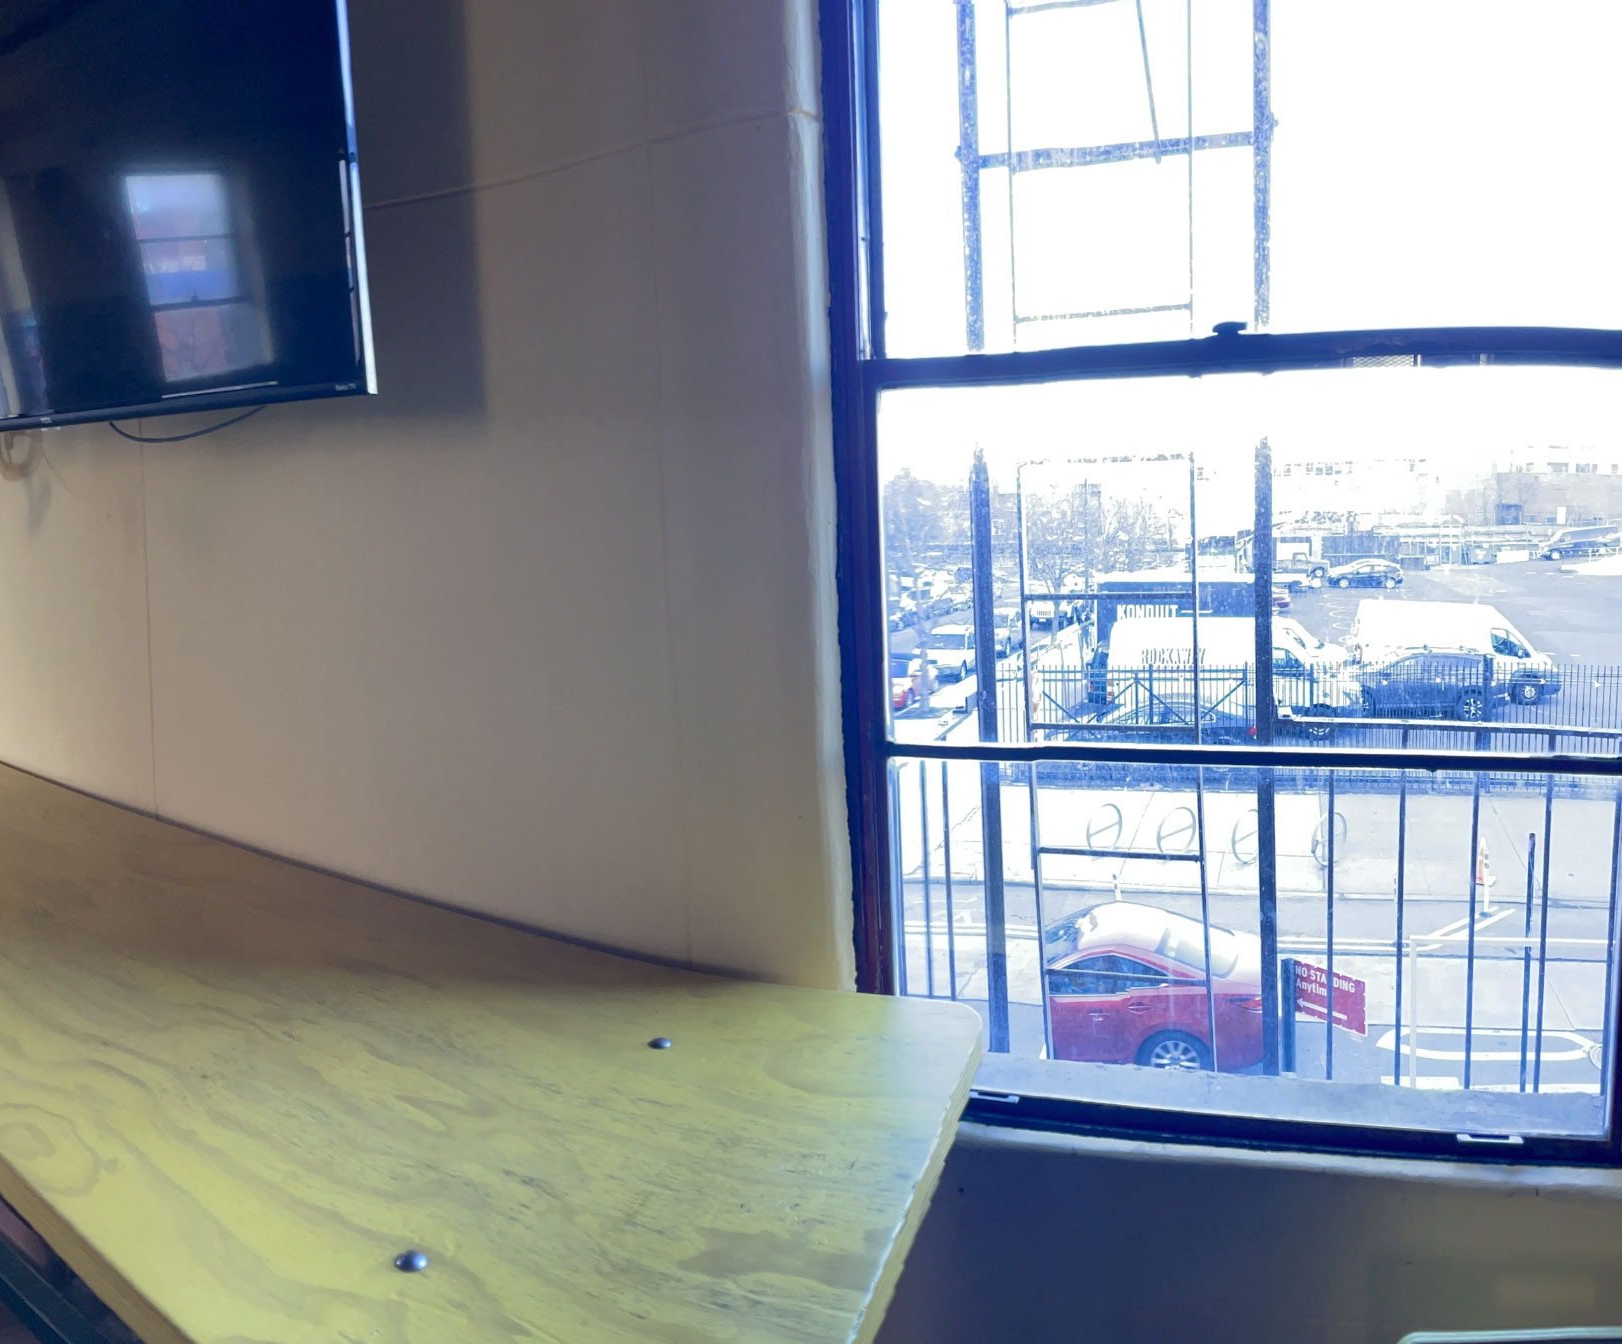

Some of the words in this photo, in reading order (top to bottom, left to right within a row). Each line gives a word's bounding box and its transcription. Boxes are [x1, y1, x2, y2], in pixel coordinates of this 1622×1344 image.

[1140, 648, 1206, 665] ROCKAWY
[1296, 965, 1308, 977] NO
[1310, 970, 1355, 993] STADING
[1296, 978, 1327, 997] Anytim
